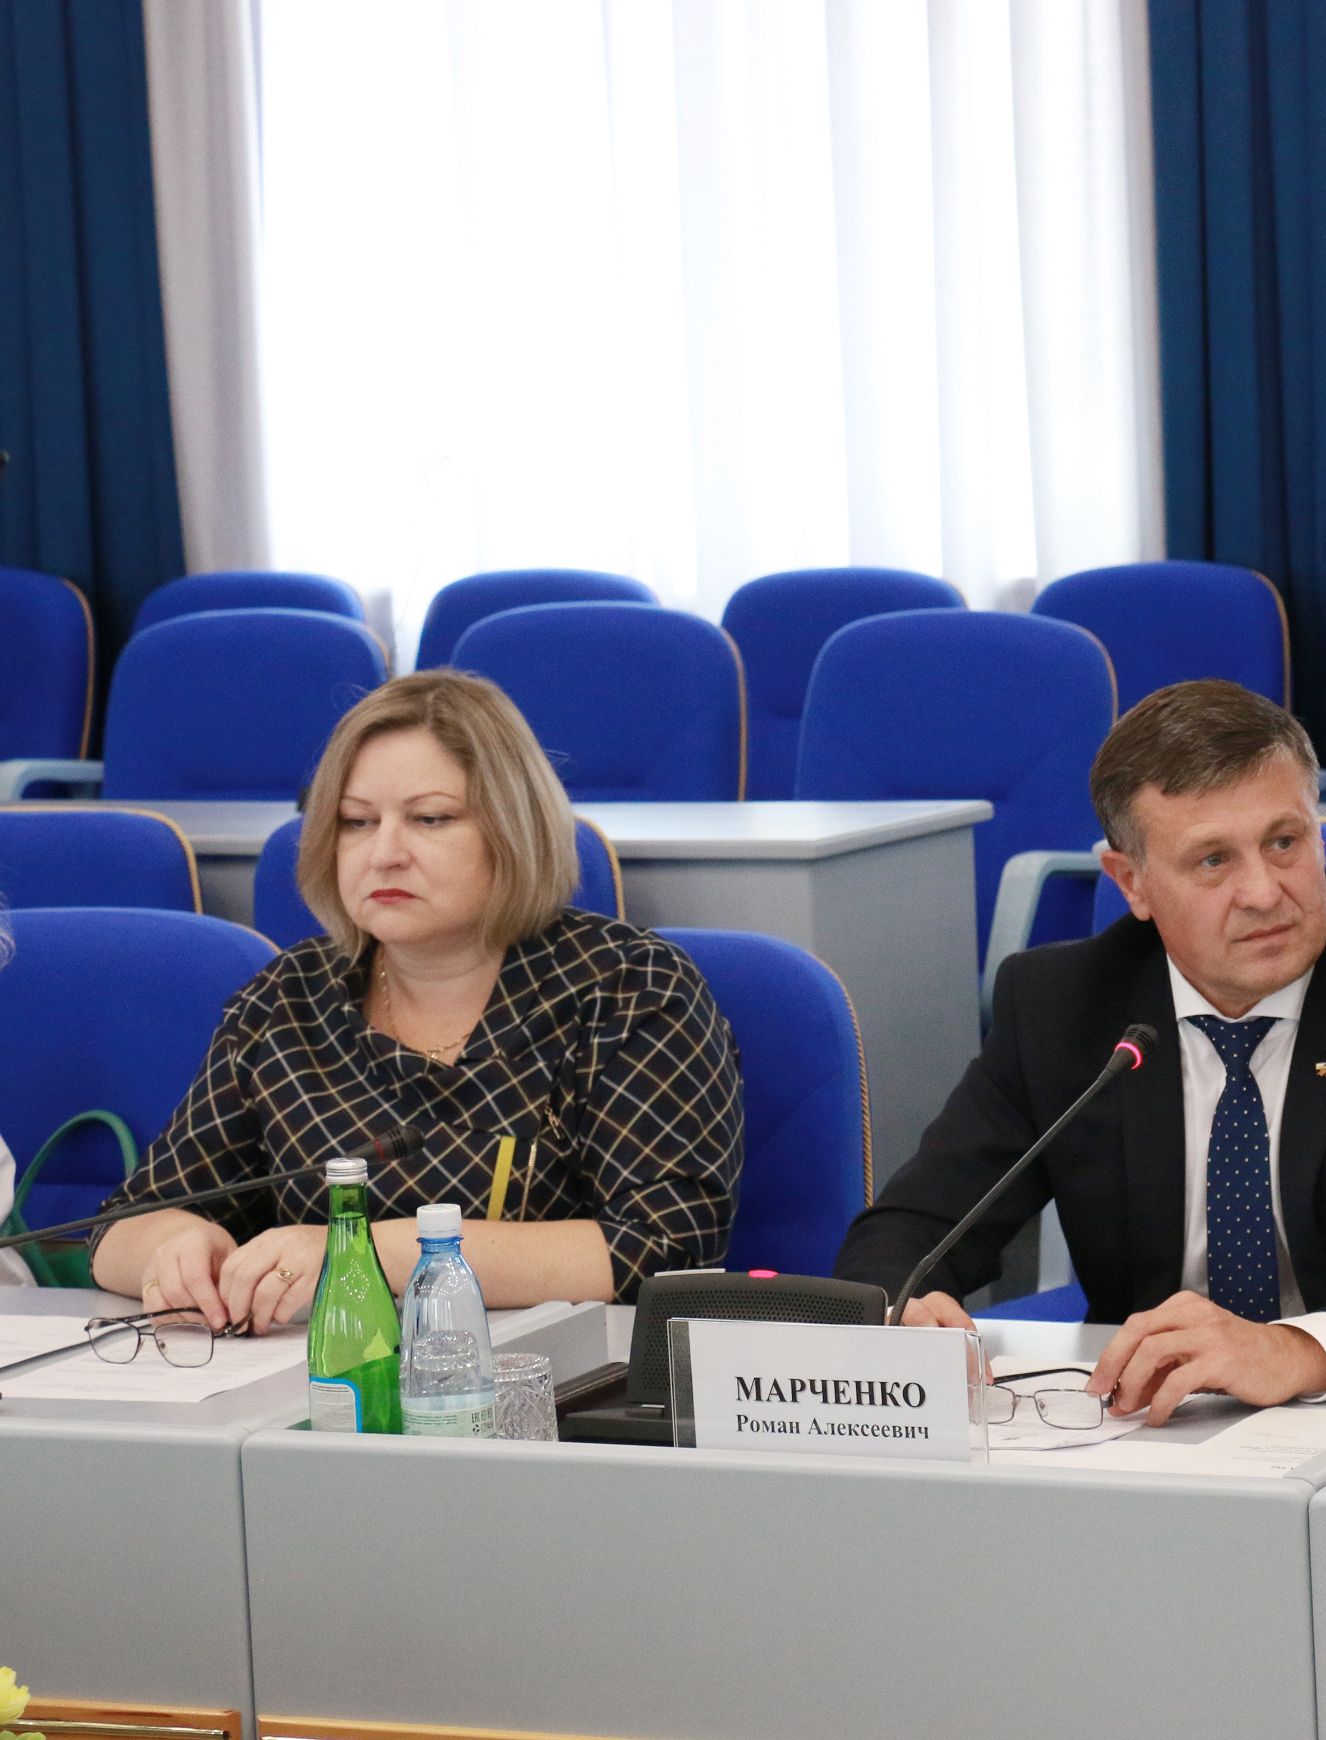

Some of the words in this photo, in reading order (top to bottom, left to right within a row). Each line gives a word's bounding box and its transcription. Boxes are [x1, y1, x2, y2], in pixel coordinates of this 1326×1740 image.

[735, 1376, 926, 1408] МАРЧЕНКО
[736, 1414, 800, 1434] Роман
[808, 1417, 929, 1440] Алексеевич
